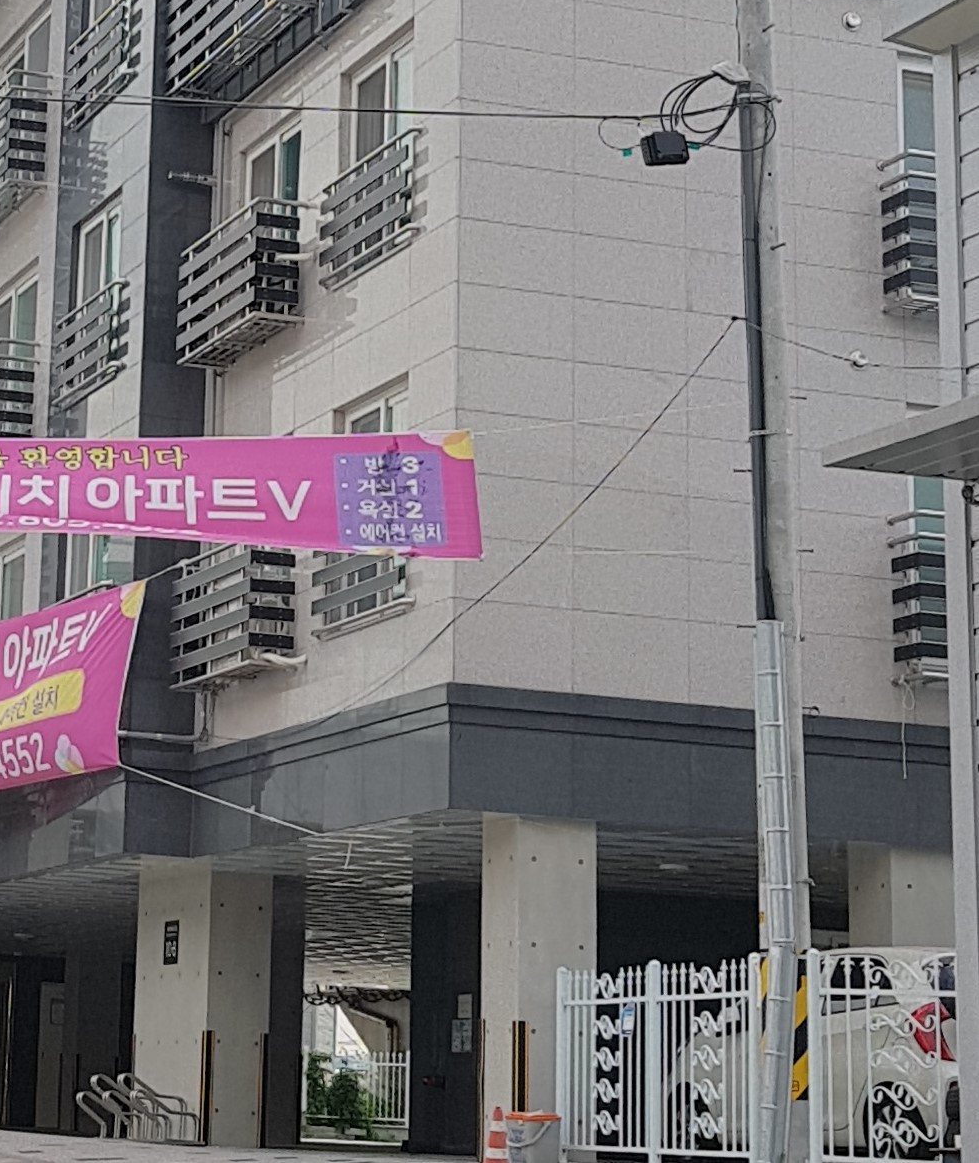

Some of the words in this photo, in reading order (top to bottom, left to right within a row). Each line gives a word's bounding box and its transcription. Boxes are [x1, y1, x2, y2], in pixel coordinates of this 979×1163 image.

[18, 445, 188, 470] 환영합니다
[402, 456, 419, 474] 3
[406, 479, 418, 496] 1
[86, 475, 311, 525] 아파트V
[406, 501, 423, 519] 2
[411, 523, 441, 543] 설치
[4, 603, 113, 688] 아파트V
